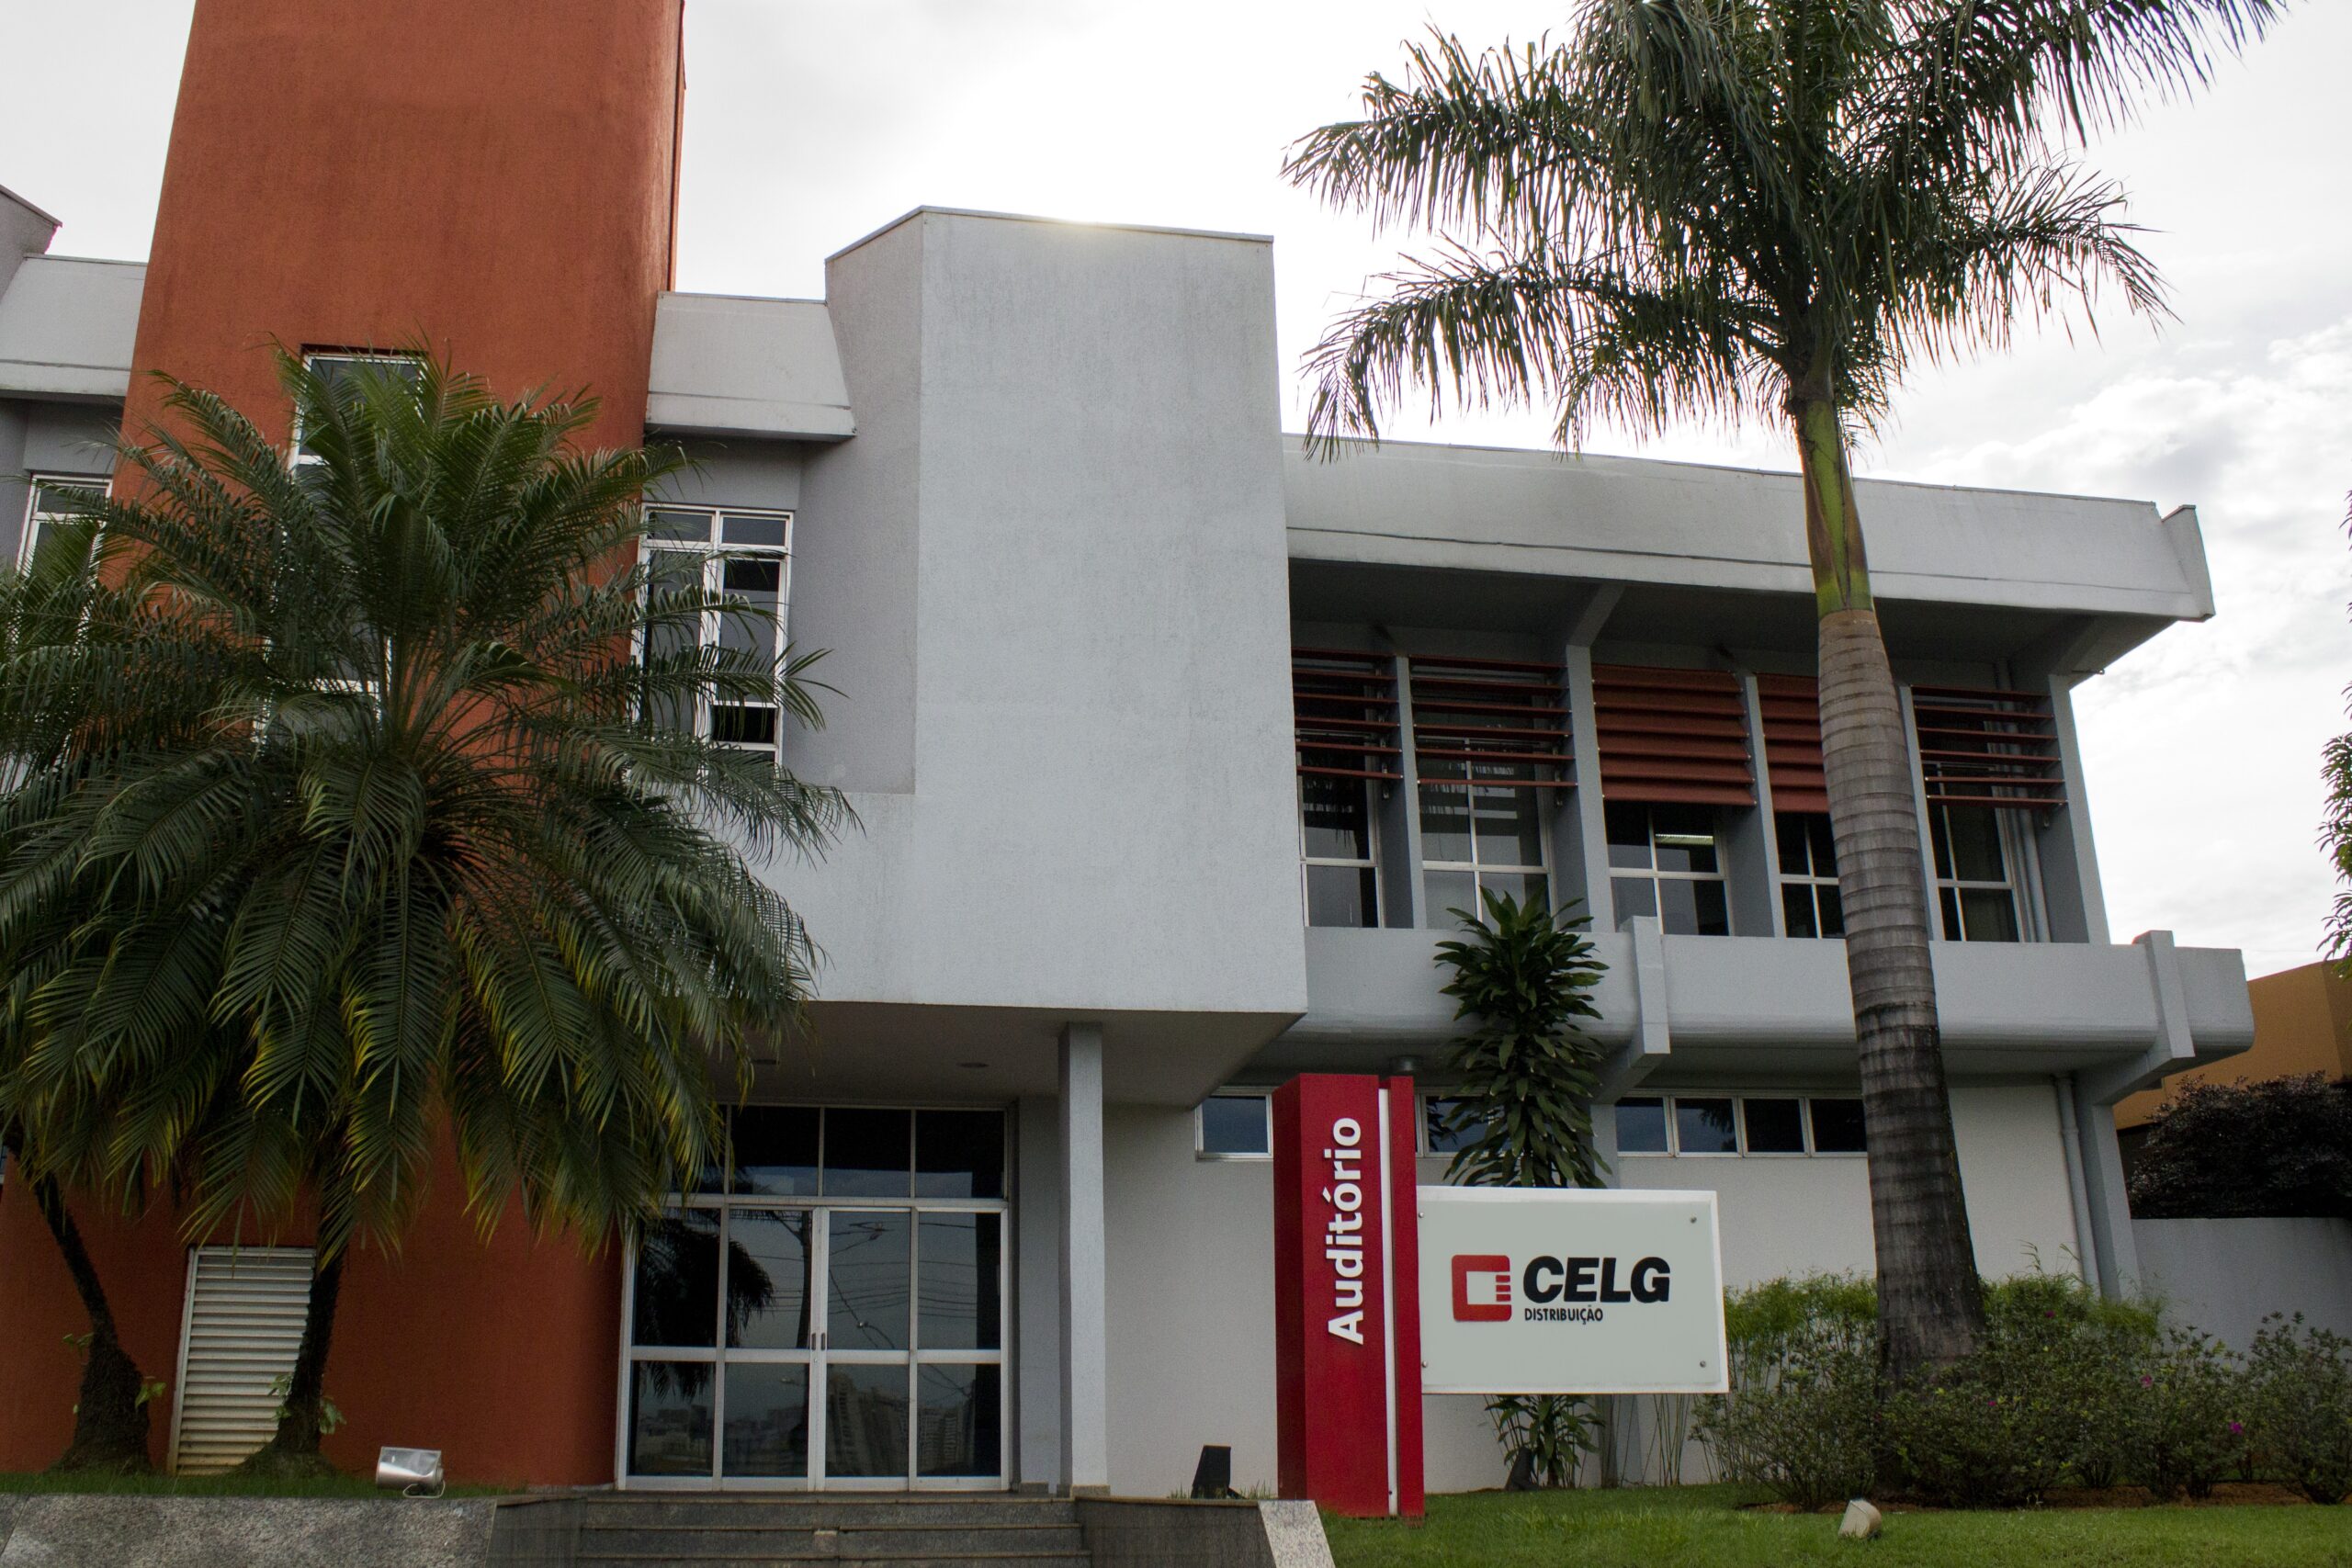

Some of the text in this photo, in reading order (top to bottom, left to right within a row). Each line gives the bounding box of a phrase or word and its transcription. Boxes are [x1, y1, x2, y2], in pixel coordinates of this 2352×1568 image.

[1322, 1117, 1363, 1345] Auditório
[1522, 1255, 1671, 1303] CELG
[1524, 1304, 1604, 1325] DISTRIBUIÇÃO
